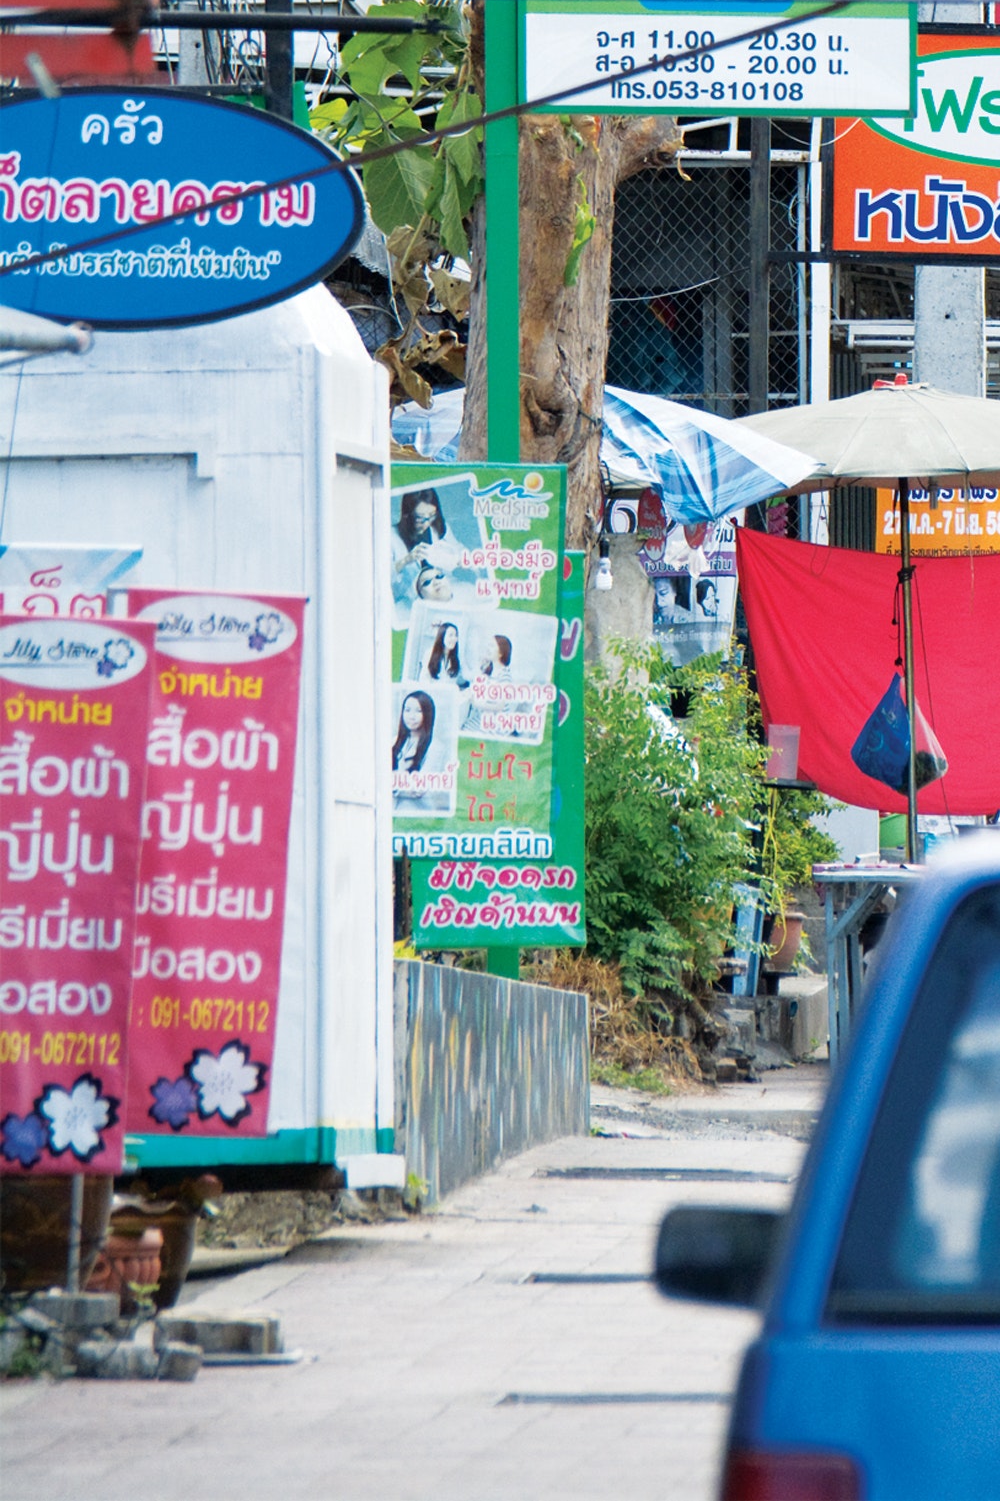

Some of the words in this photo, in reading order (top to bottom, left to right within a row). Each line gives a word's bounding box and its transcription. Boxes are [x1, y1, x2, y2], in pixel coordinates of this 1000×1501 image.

[748, 56, 817, 76] 20.00
[81, 99, 164, 145] ครัว
[467, 743, 533, 781] มั่นใจ
[466, 790, 495, 822] ได้
[151, 997, 270, 1033] 091-0672112
